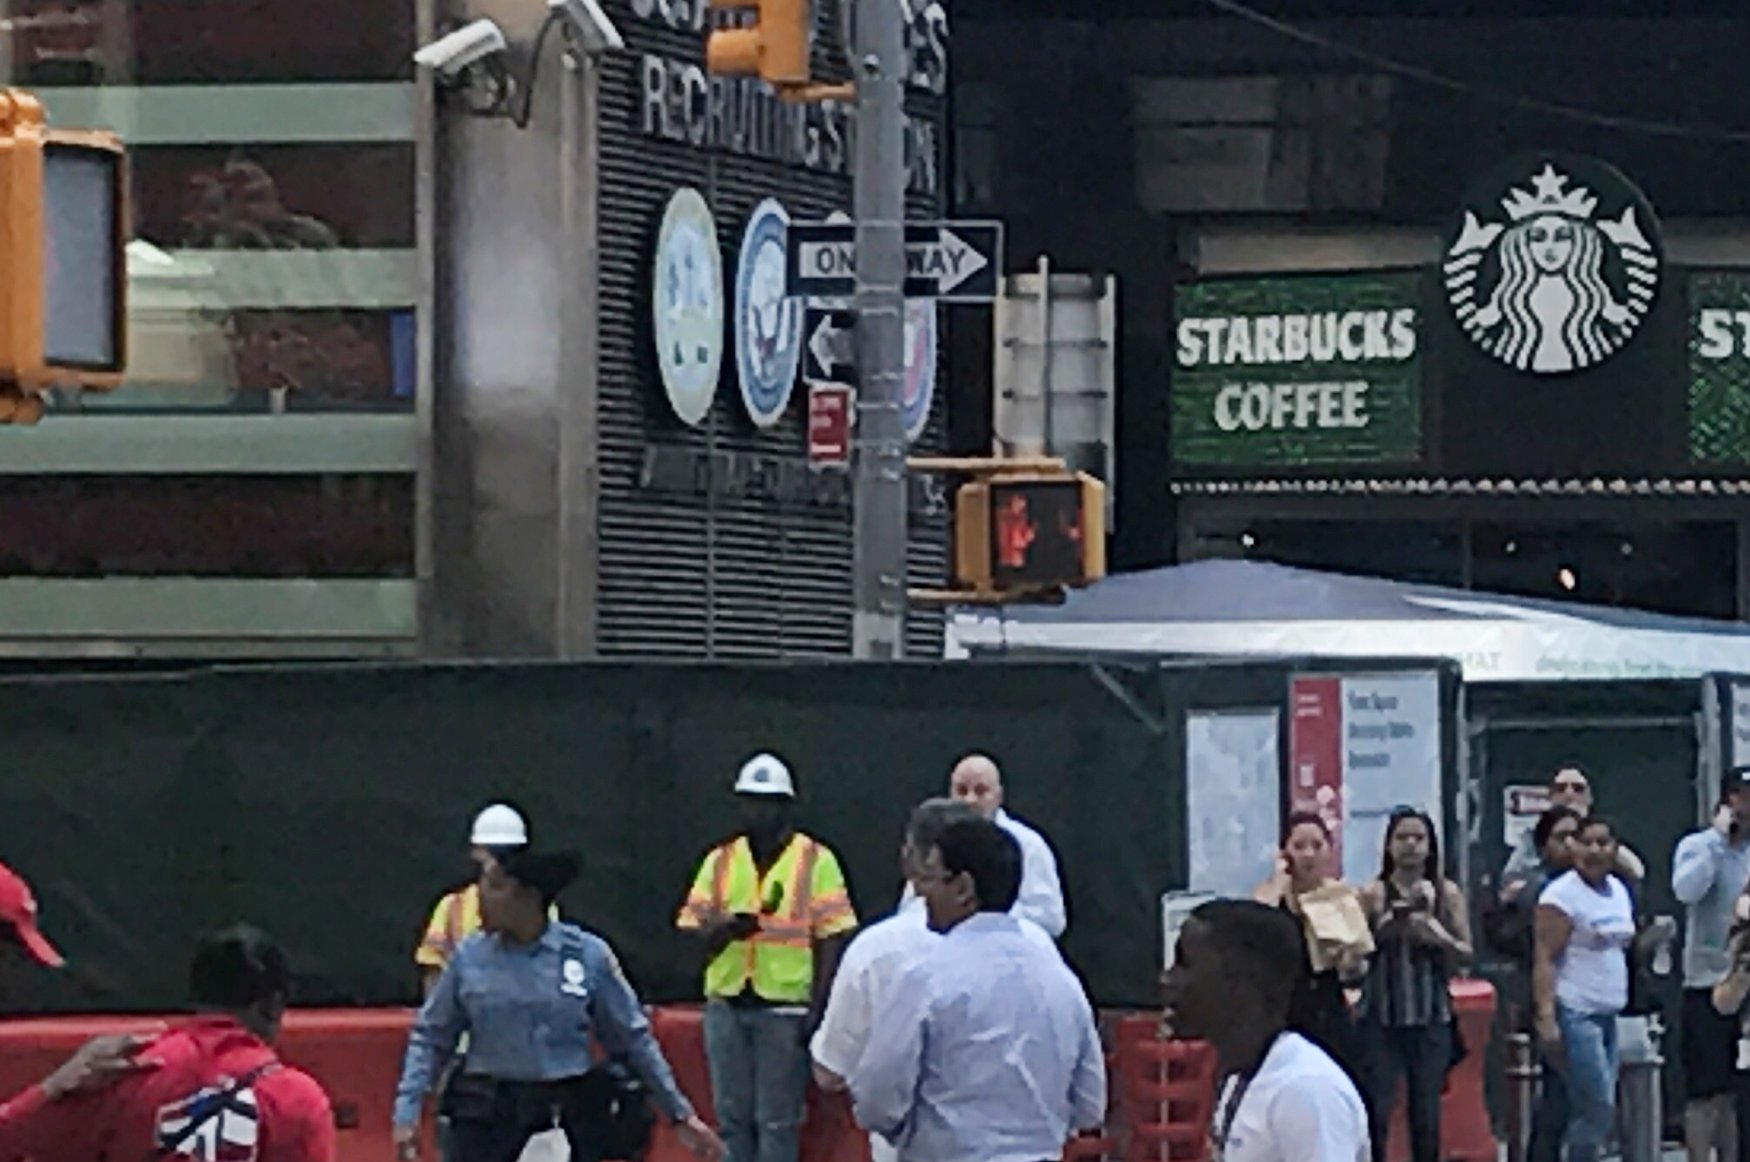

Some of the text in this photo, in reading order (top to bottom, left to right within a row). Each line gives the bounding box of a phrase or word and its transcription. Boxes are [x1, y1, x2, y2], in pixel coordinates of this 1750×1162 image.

[815, 247, 856, 276] ON
[1176, 308, 1417, 366] STARBUCKS
[1214, 381, 1369, 431] COFFEE
